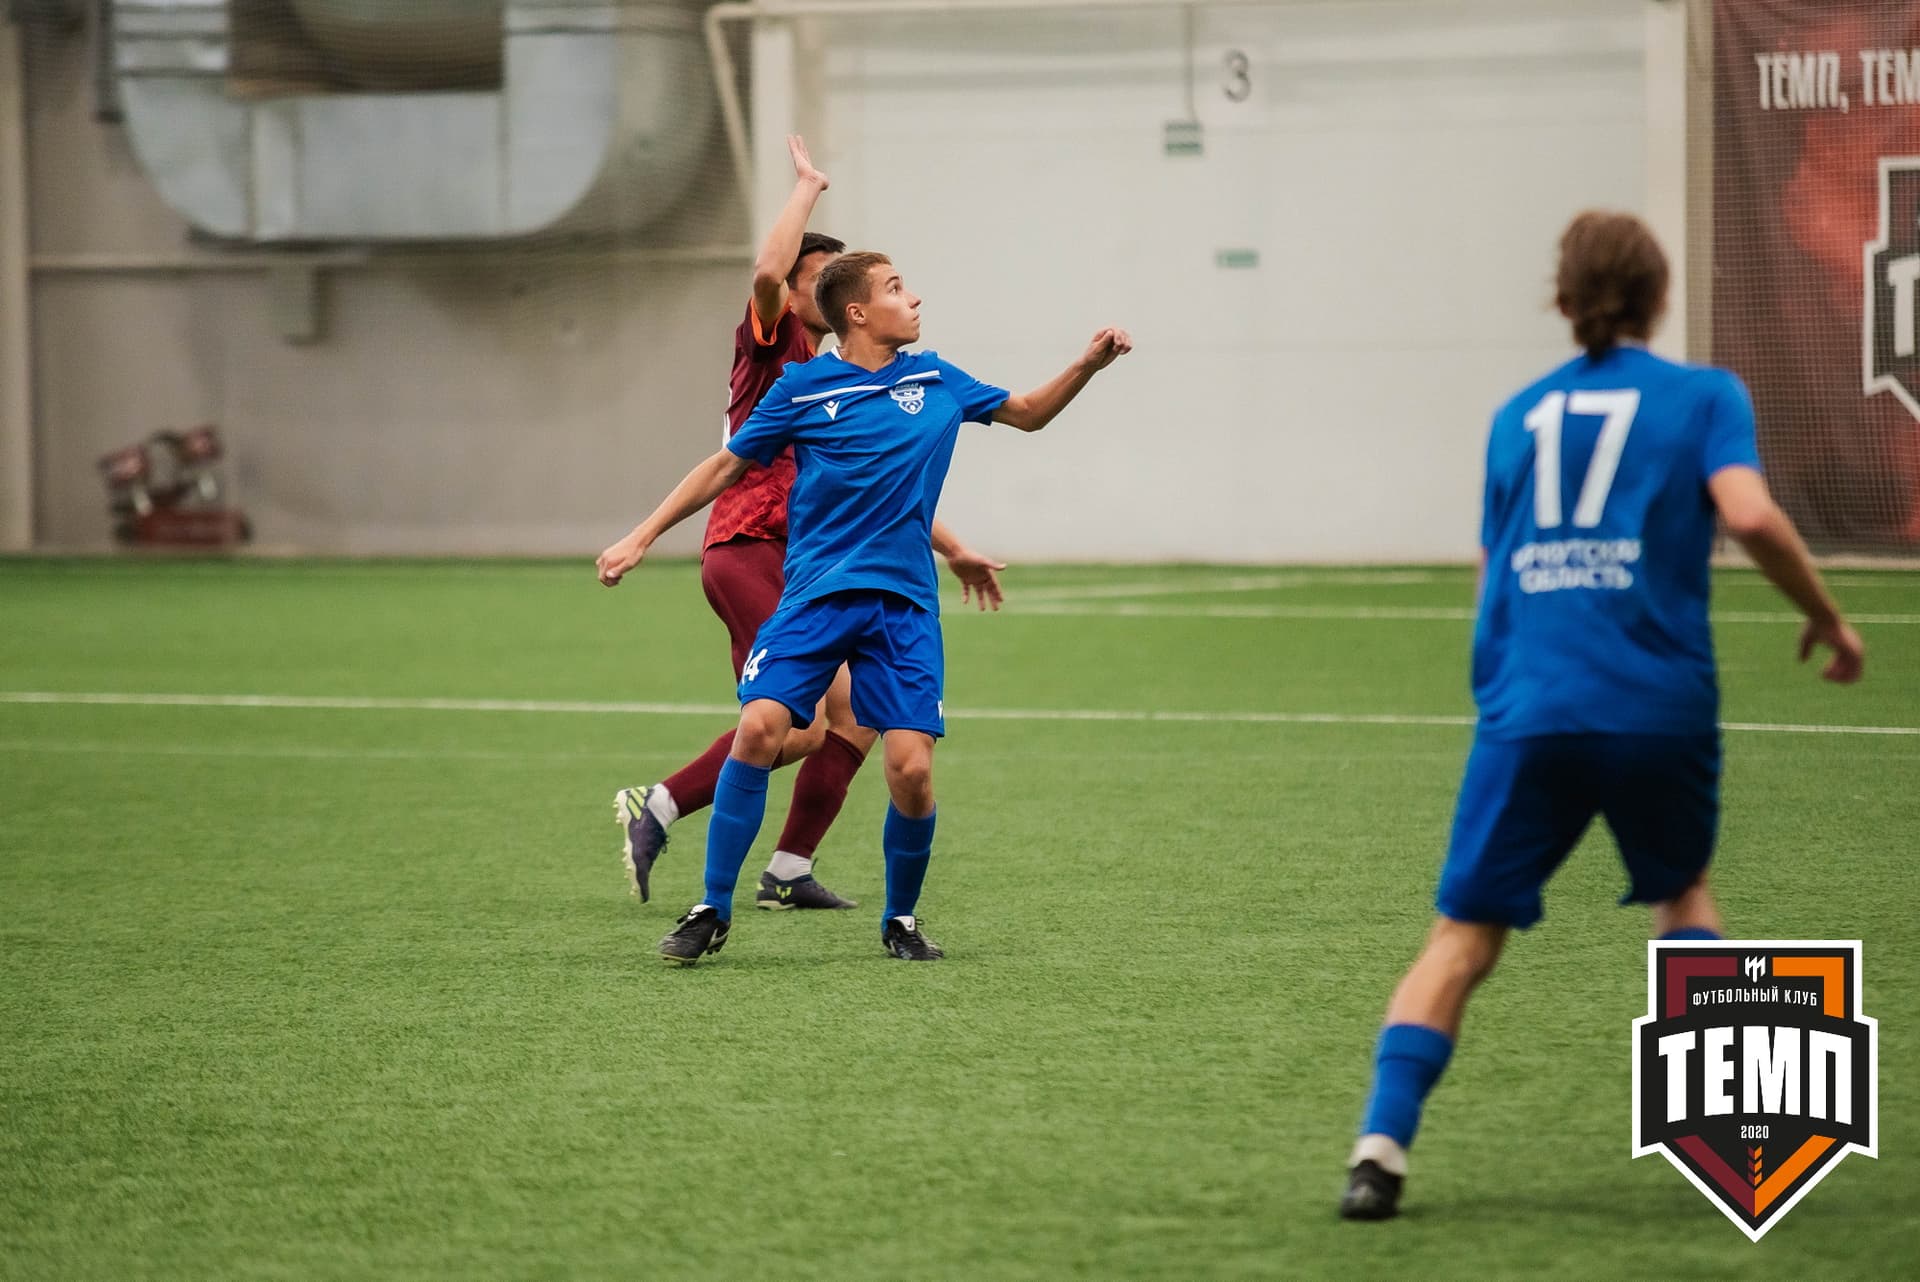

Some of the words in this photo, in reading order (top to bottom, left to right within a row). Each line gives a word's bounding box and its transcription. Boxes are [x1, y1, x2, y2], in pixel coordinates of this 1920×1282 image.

[1224, 49, 1250, 102] 3
[1754, 52, 1849, 113] ТЕМП,
[1523, 388, 1641, 529] 17
